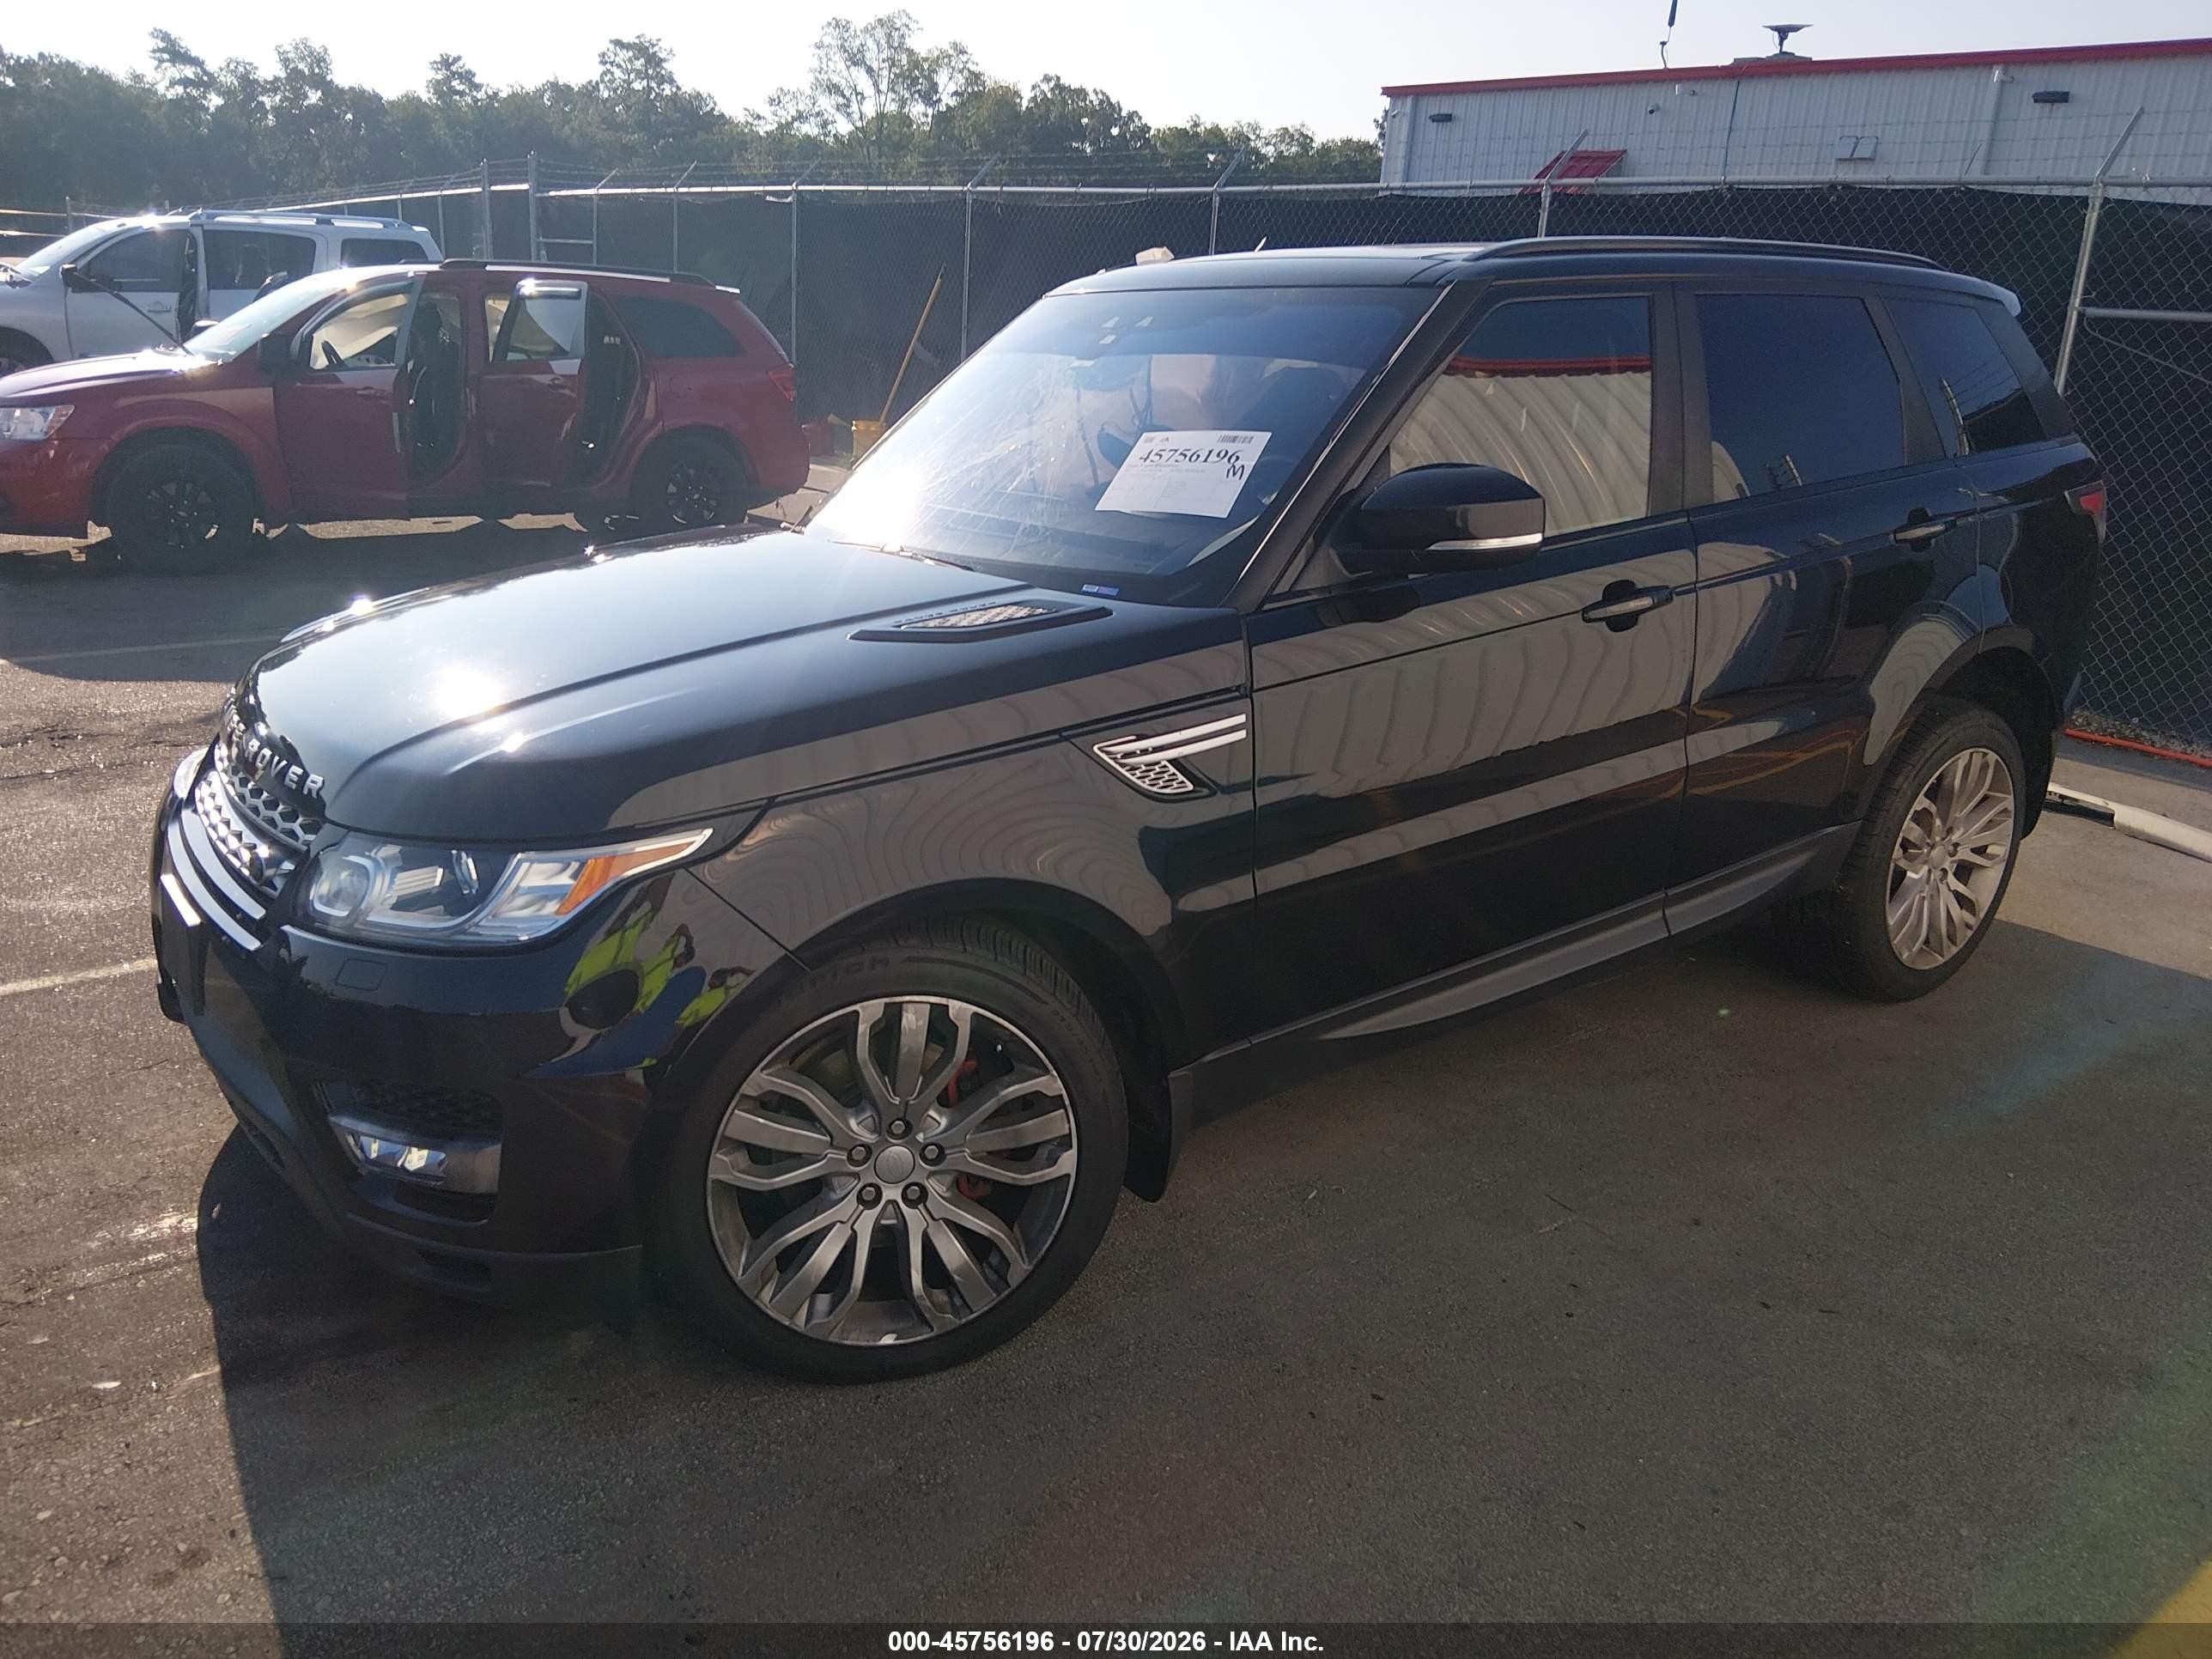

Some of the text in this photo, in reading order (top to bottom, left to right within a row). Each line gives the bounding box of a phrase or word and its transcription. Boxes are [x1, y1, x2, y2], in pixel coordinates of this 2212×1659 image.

[1139, 447, 1244, 465] 45756196
[1225, 463, 1245, 481] M
[245, 738, 324, 799] ROVER
